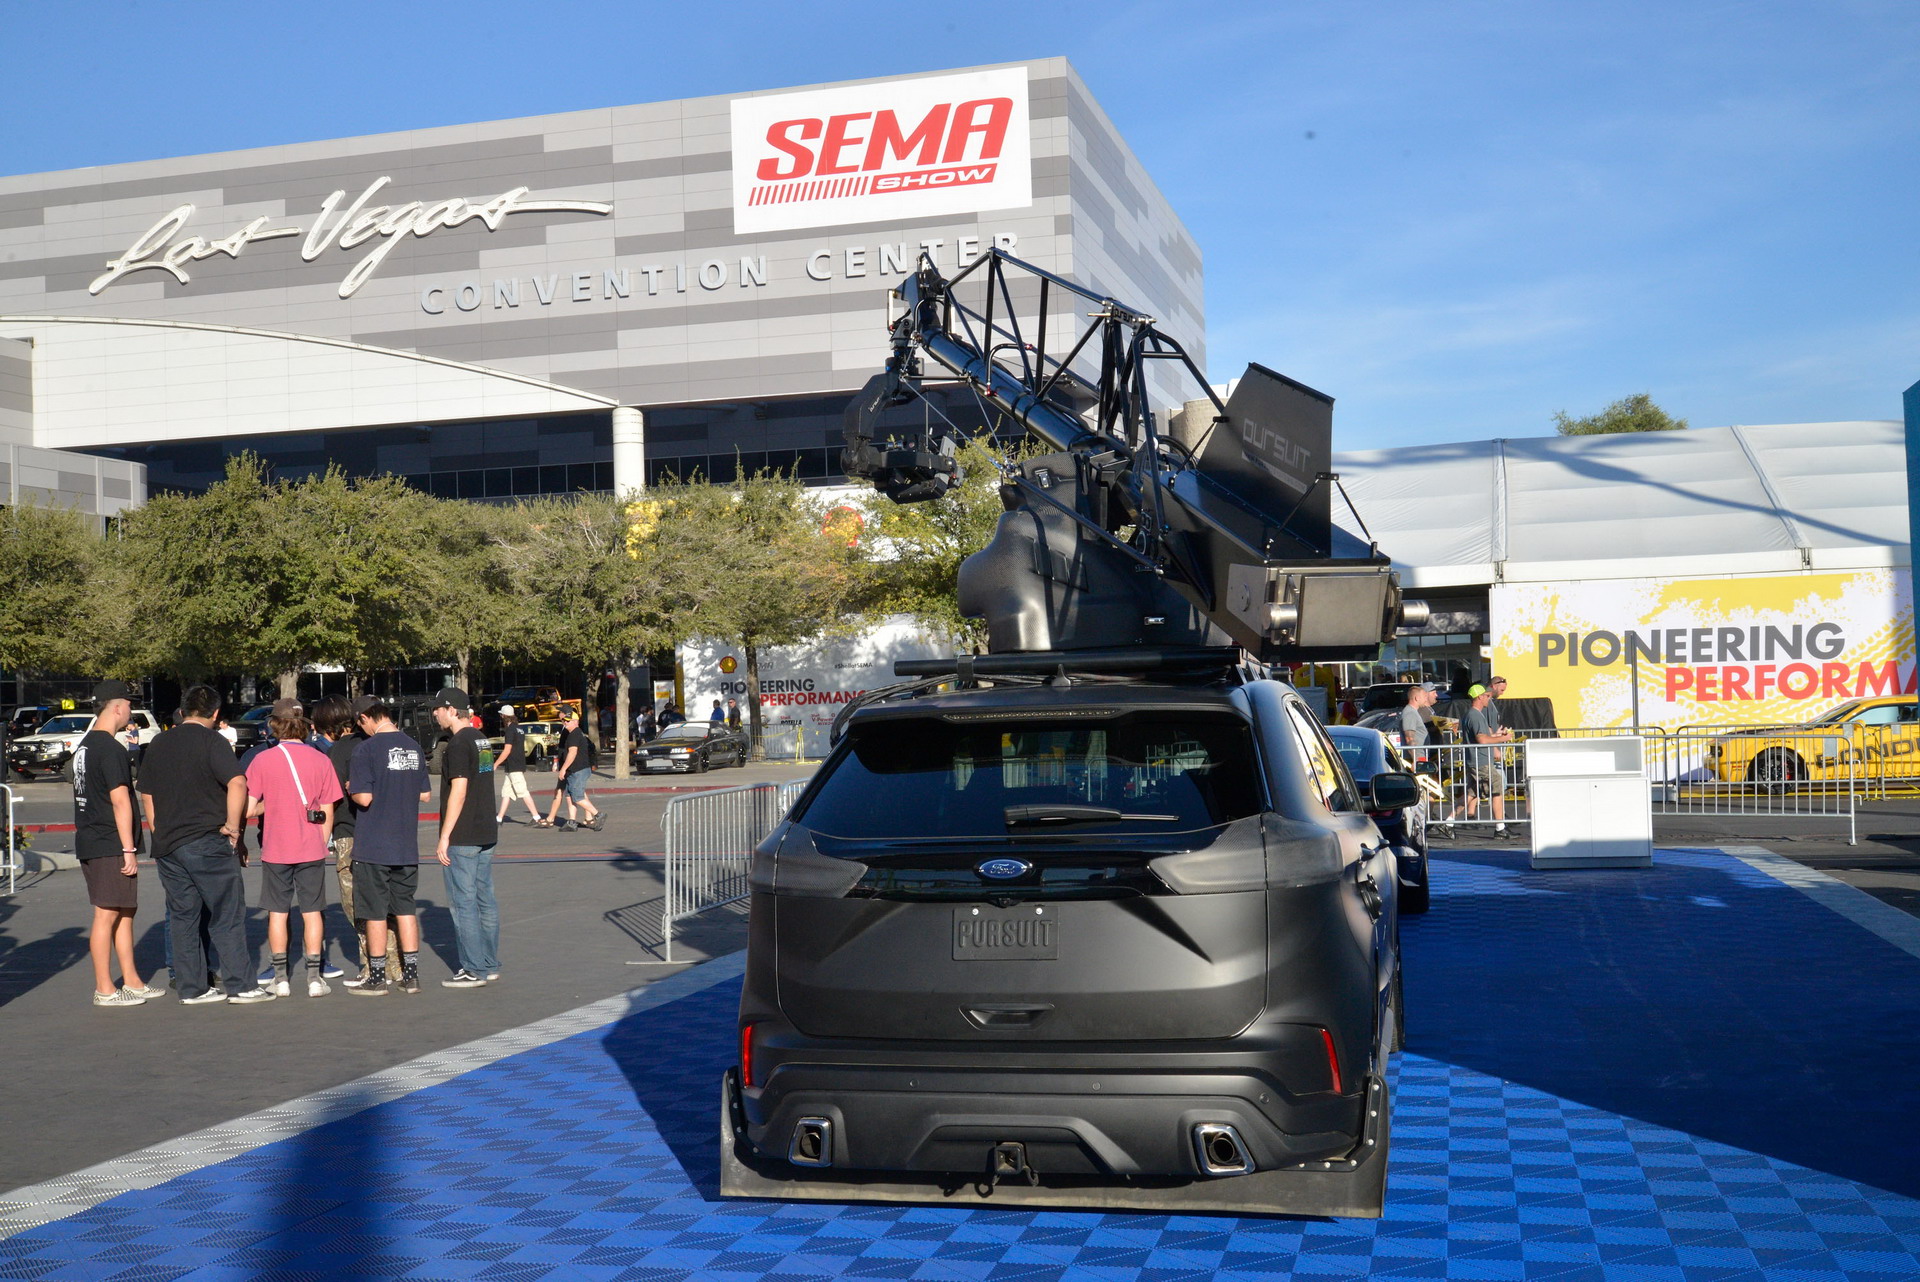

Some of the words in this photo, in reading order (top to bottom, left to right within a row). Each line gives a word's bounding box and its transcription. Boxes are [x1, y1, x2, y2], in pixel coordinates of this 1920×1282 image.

[756, 96, 1014, 181] SEMA
[875, 165, 992, 191] SHOW
[89, 203, 301, 296] Las
[302, 174, 612, 299] Vegas
[420, 255, 767, 315] CONVENTION
[1538, 622, 1845, 667] PIONEERING
[720, 678, 815, 695] PIOEERING
[990, 862, 1016, 875] Ford
[958, 919, 1053, 948] PURSUIT
